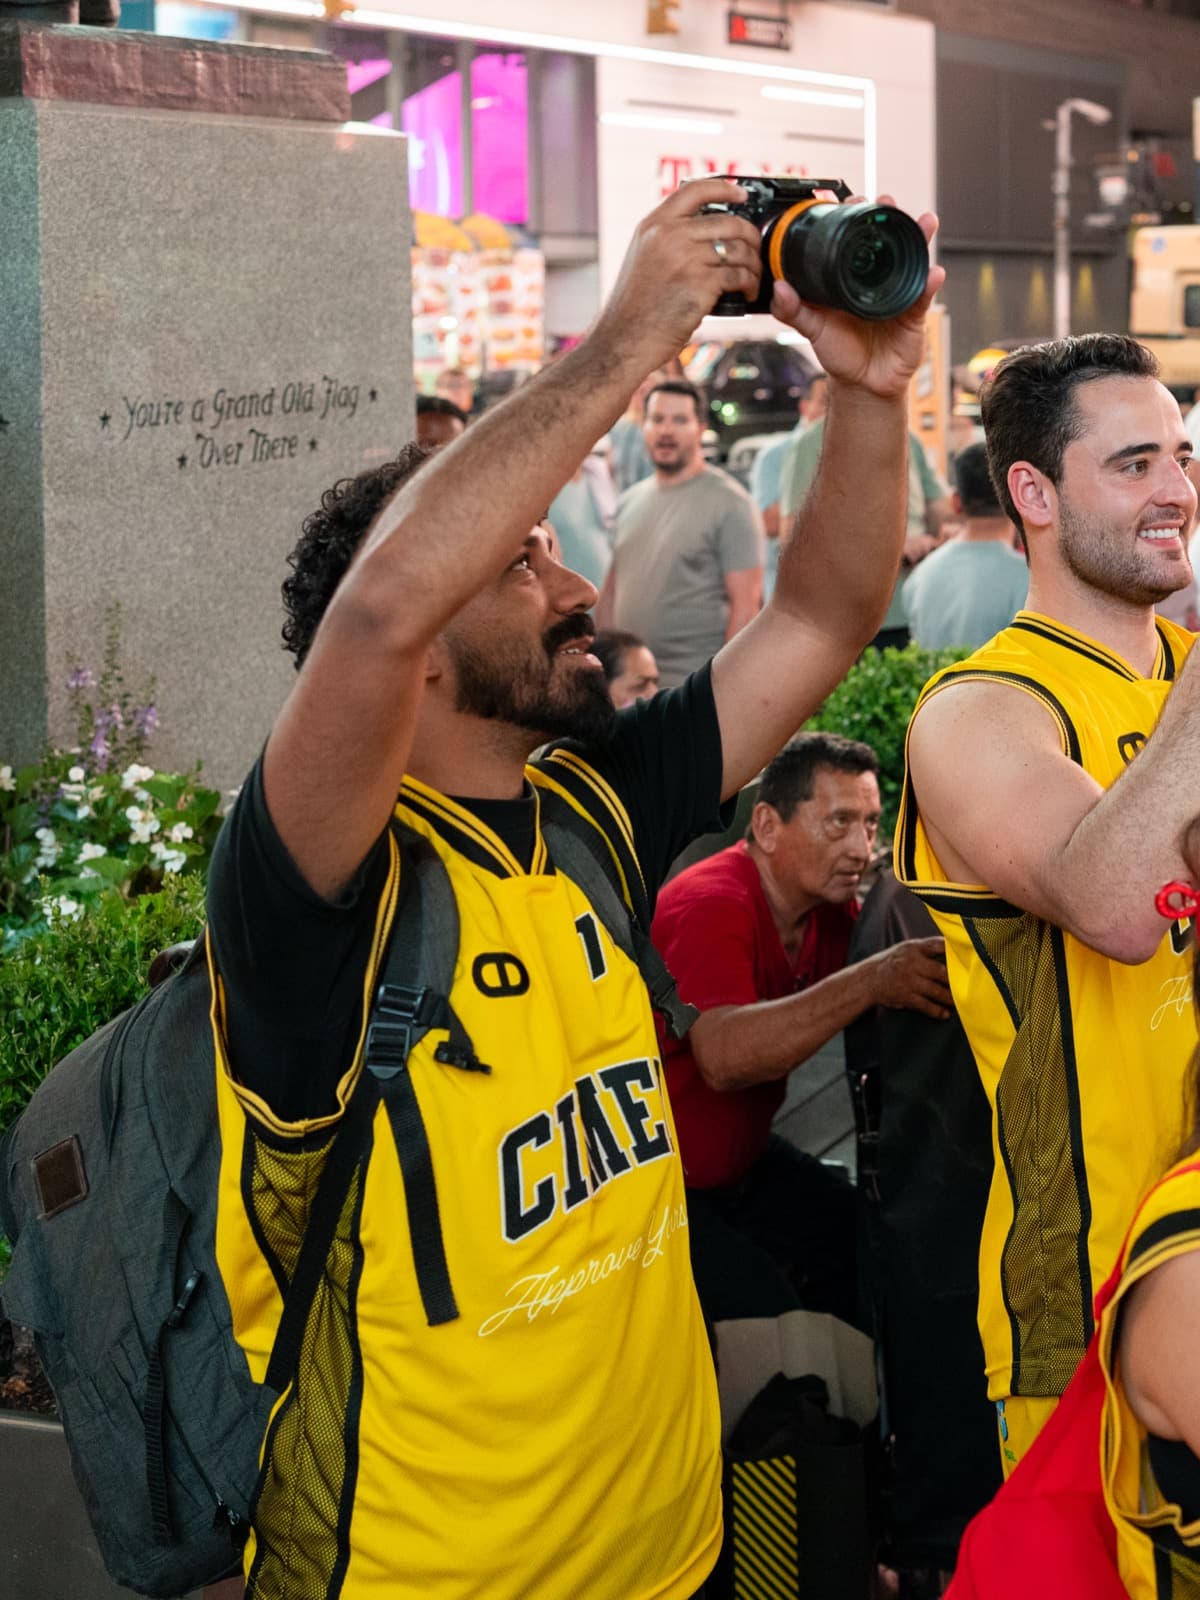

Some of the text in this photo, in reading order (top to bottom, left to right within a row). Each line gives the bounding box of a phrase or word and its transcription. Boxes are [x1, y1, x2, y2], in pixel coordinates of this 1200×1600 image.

[191, 399, 205, 423] a
[211, 387, 275, 430] Grand
[281, 381, 315, 415] Old
[320, 374, 360, 420] Flag
[196, 428, 298, 469] Over There
[574, 912, 606, 982] 1
[499, 1056, 675, 1244] CIME
[478, 1235, 643, 1337] Approve
